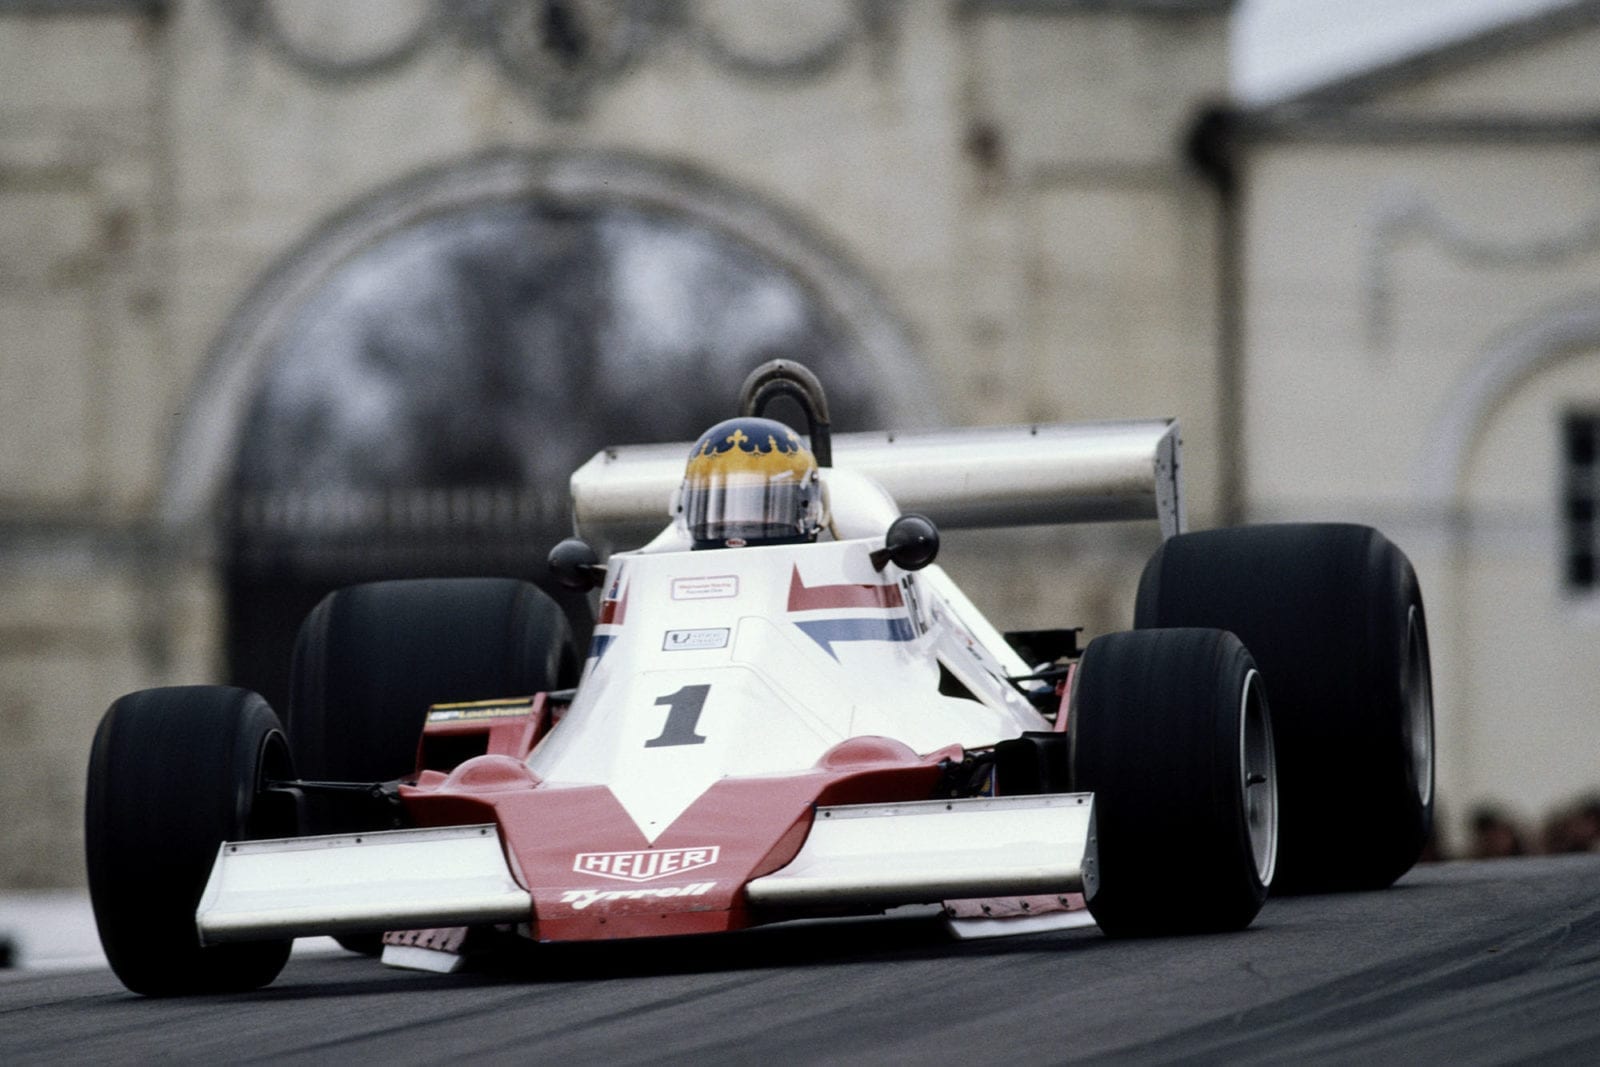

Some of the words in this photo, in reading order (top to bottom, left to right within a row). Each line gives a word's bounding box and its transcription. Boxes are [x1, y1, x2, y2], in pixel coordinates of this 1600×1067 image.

[644, 684, 712, 748] 1
[585, 850, 707, 878] HEUER
[560, 882, 718, 910] Tyrrell
